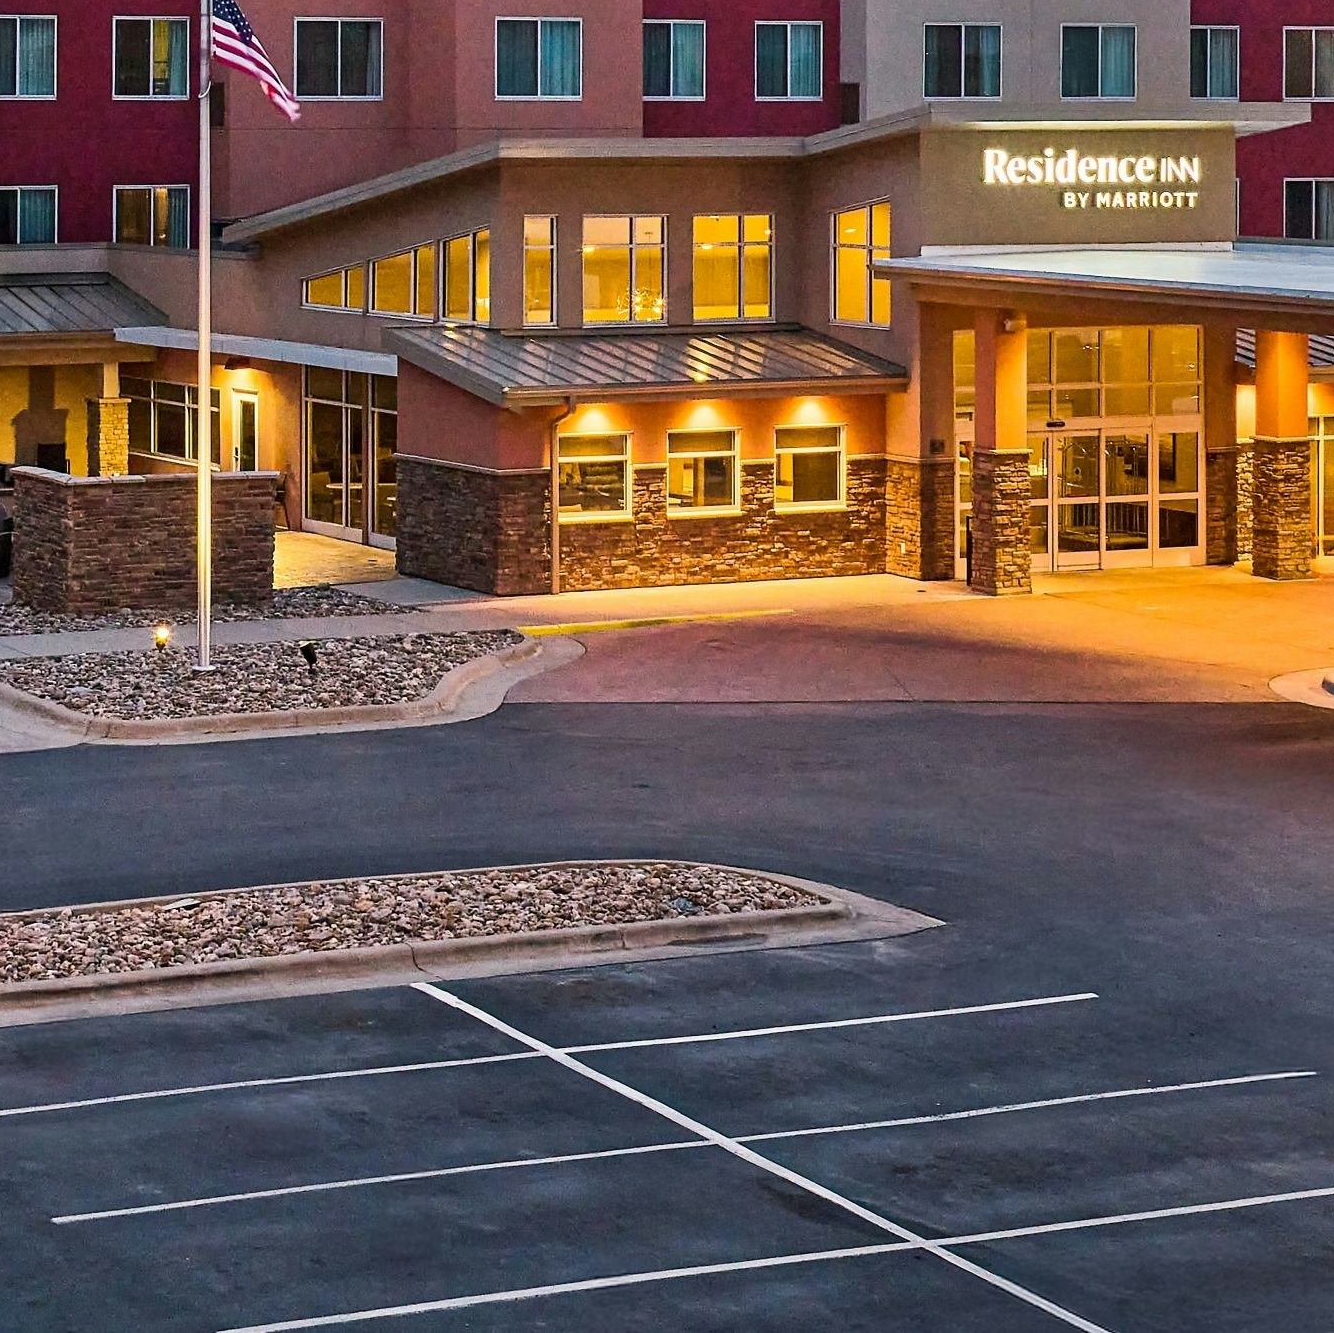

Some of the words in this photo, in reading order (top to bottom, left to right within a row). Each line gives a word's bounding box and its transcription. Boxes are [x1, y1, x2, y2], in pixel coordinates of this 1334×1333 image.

[983, 148, 1155, 184] Residence
[1160, 157, 1199, 183] INN
[1064, 192, 1090, 208] BY
[1096, 192, 1198, 208] MARRIOTT
